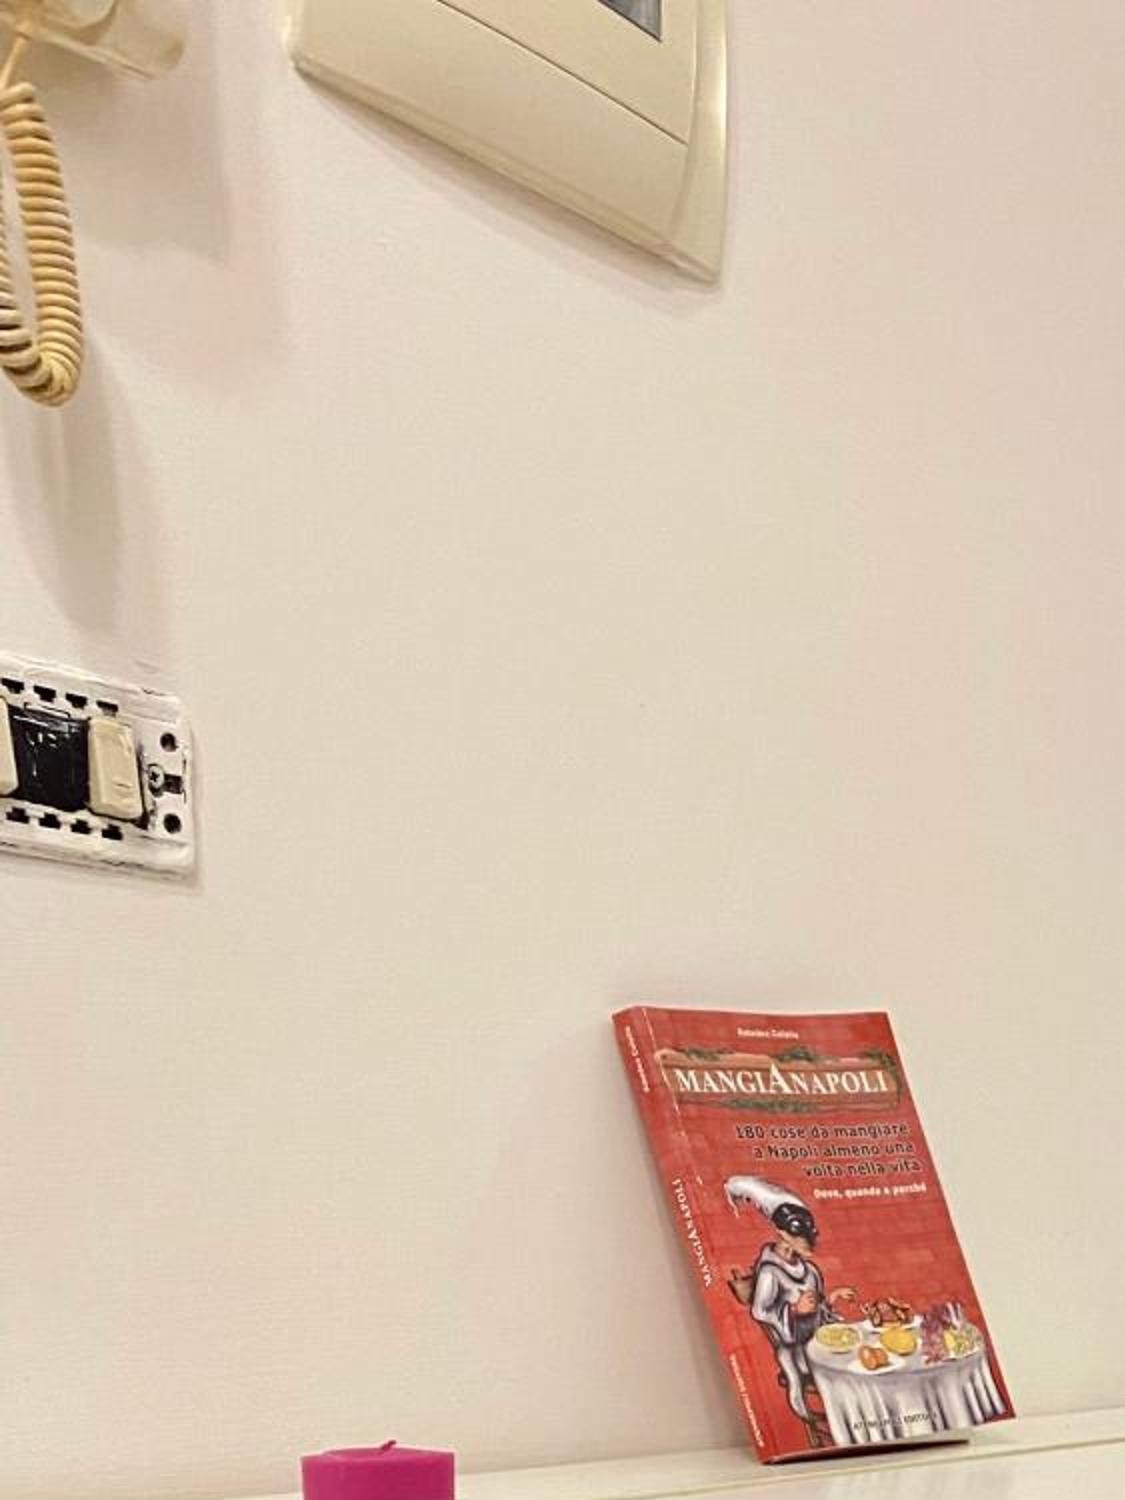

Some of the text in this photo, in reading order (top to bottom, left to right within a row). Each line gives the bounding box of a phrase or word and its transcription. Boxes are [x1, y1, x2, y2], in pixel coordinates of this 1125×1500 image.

[675, 1064, 888, 1094] MANGIANAPOLI
[736, 1124, 908, 1140] 180 cose da mangiare
[755, 1143, 913, 1160] a Napoli almeno una
[805, 1158, 920, 1177] volta nella vita
